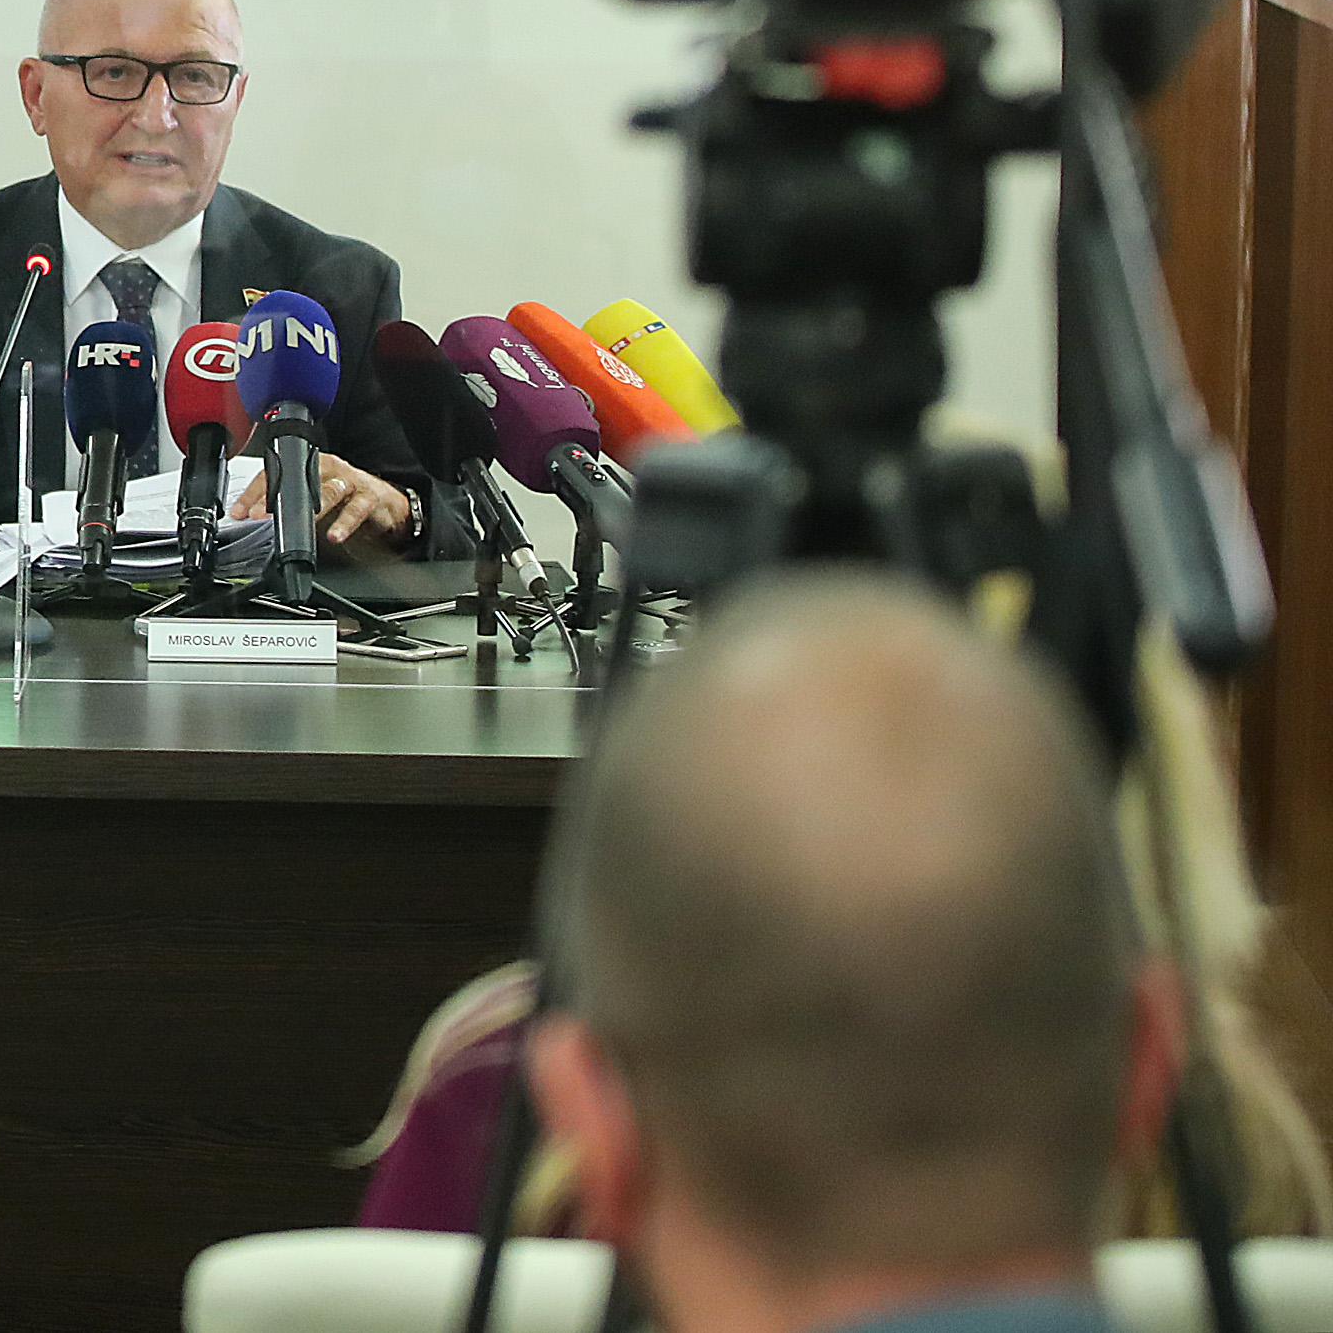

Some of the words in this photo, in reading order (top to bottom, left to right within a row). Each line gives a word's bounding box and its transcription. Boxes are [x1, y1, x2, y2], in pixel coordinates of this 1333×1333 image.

[286, 317, 338, 364] N1
[77, 343, 141, 368] HRT
[168, 635, 235, 646] MIROSLAV
[242, 634, 318, 648] ŠEPAROVIĆ
